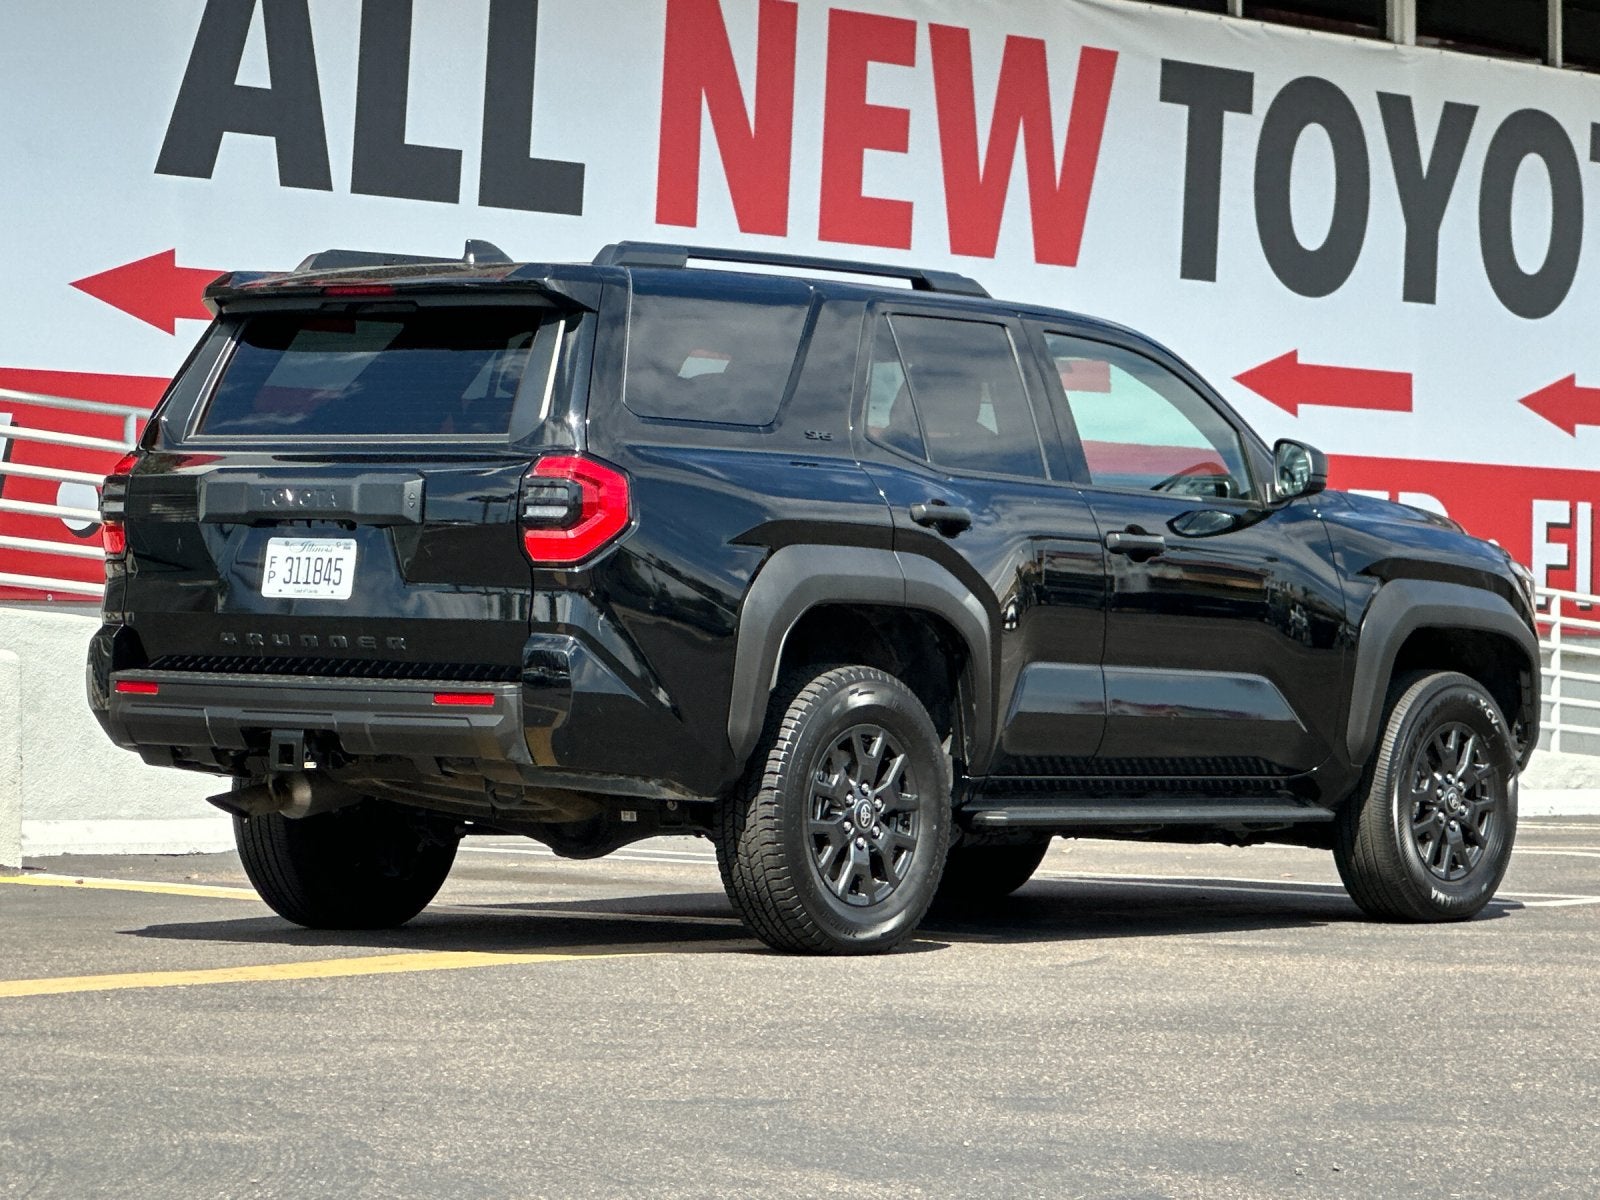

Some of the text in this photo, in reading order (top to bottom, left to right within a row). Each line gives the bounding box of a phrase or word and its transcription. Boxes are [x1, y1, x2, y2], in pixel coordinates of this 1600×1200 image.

[154, 0, 1600, 319] ALL NEW TOYO
[260, 488, 338, 508] TOYOTA
[283, 556, 344, 586] 311845
[219, 632, 406, 650] 4RUNNER
